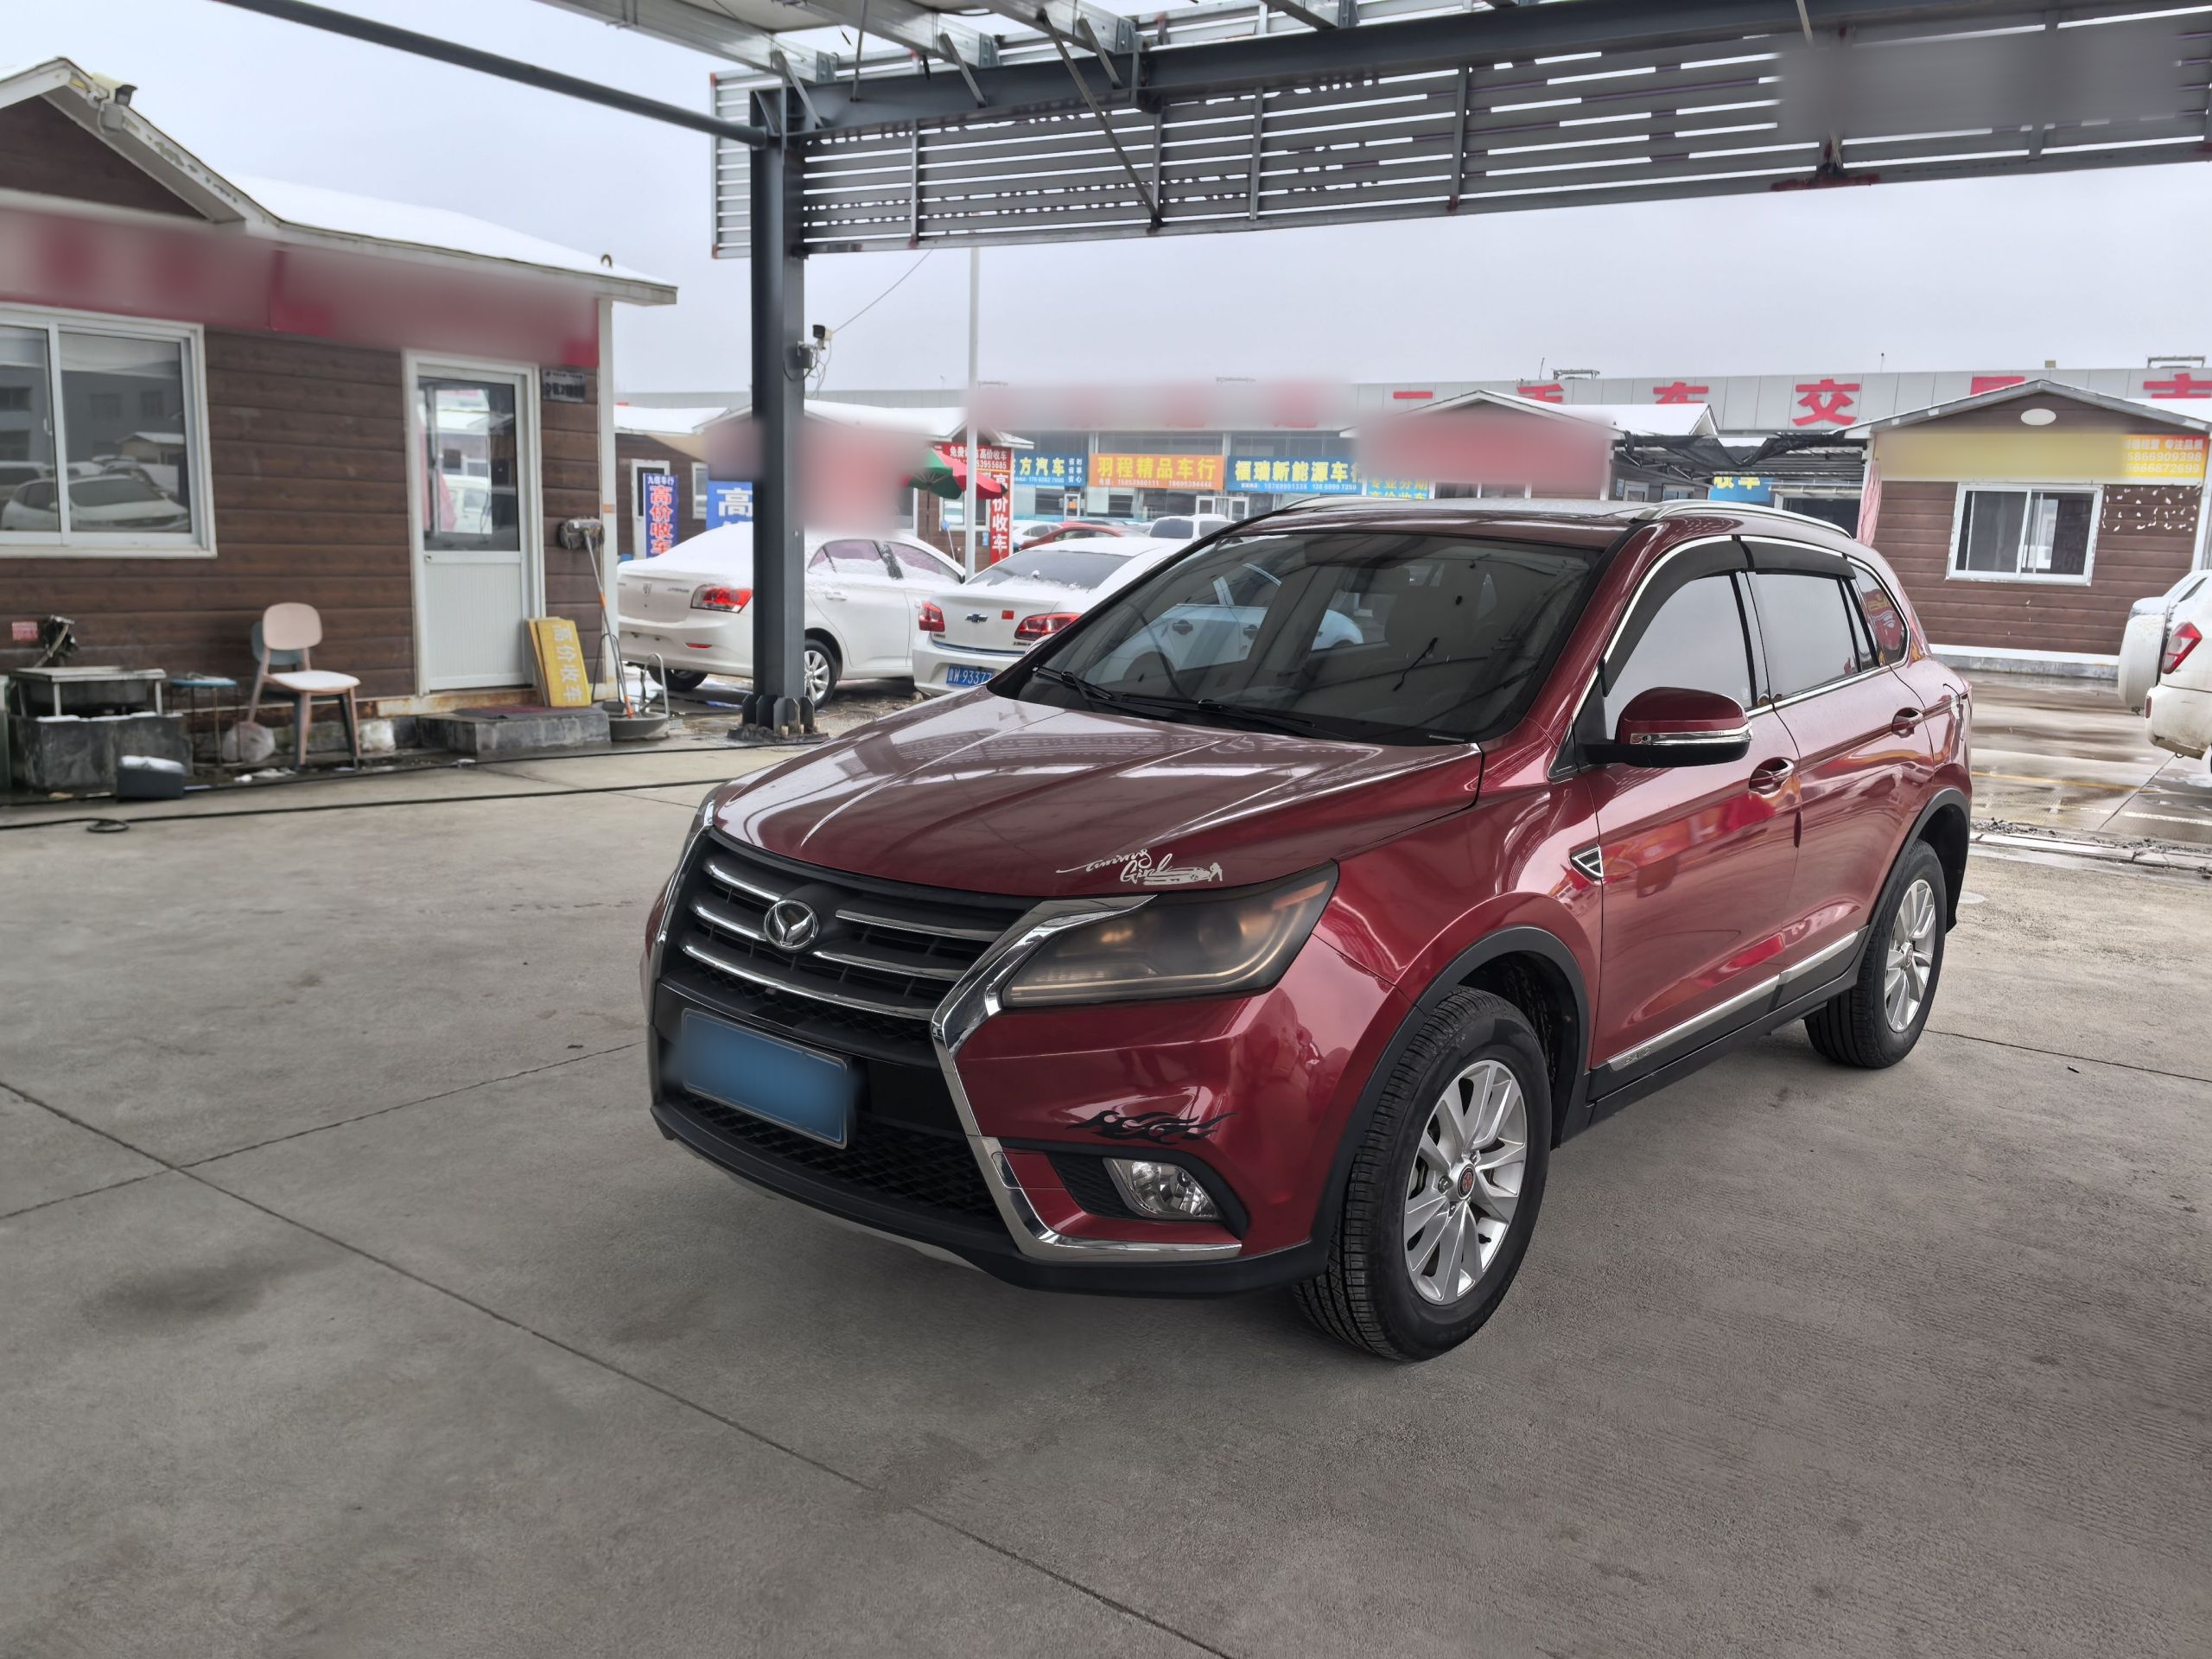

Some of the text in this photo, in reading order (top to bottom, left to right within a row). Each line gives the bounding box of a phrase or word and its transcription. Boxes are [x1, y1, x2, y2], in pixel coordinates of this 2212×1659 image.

[950, 445, 1007, 461] 免费高价收车
[1014, 457, 1065, 476] 方汽车
[1097, 456, 1216, 480] 羽程精品车行
[649, 486, 673, 554] 高价收车
[992, 474, 1008, 551] 高价收车
